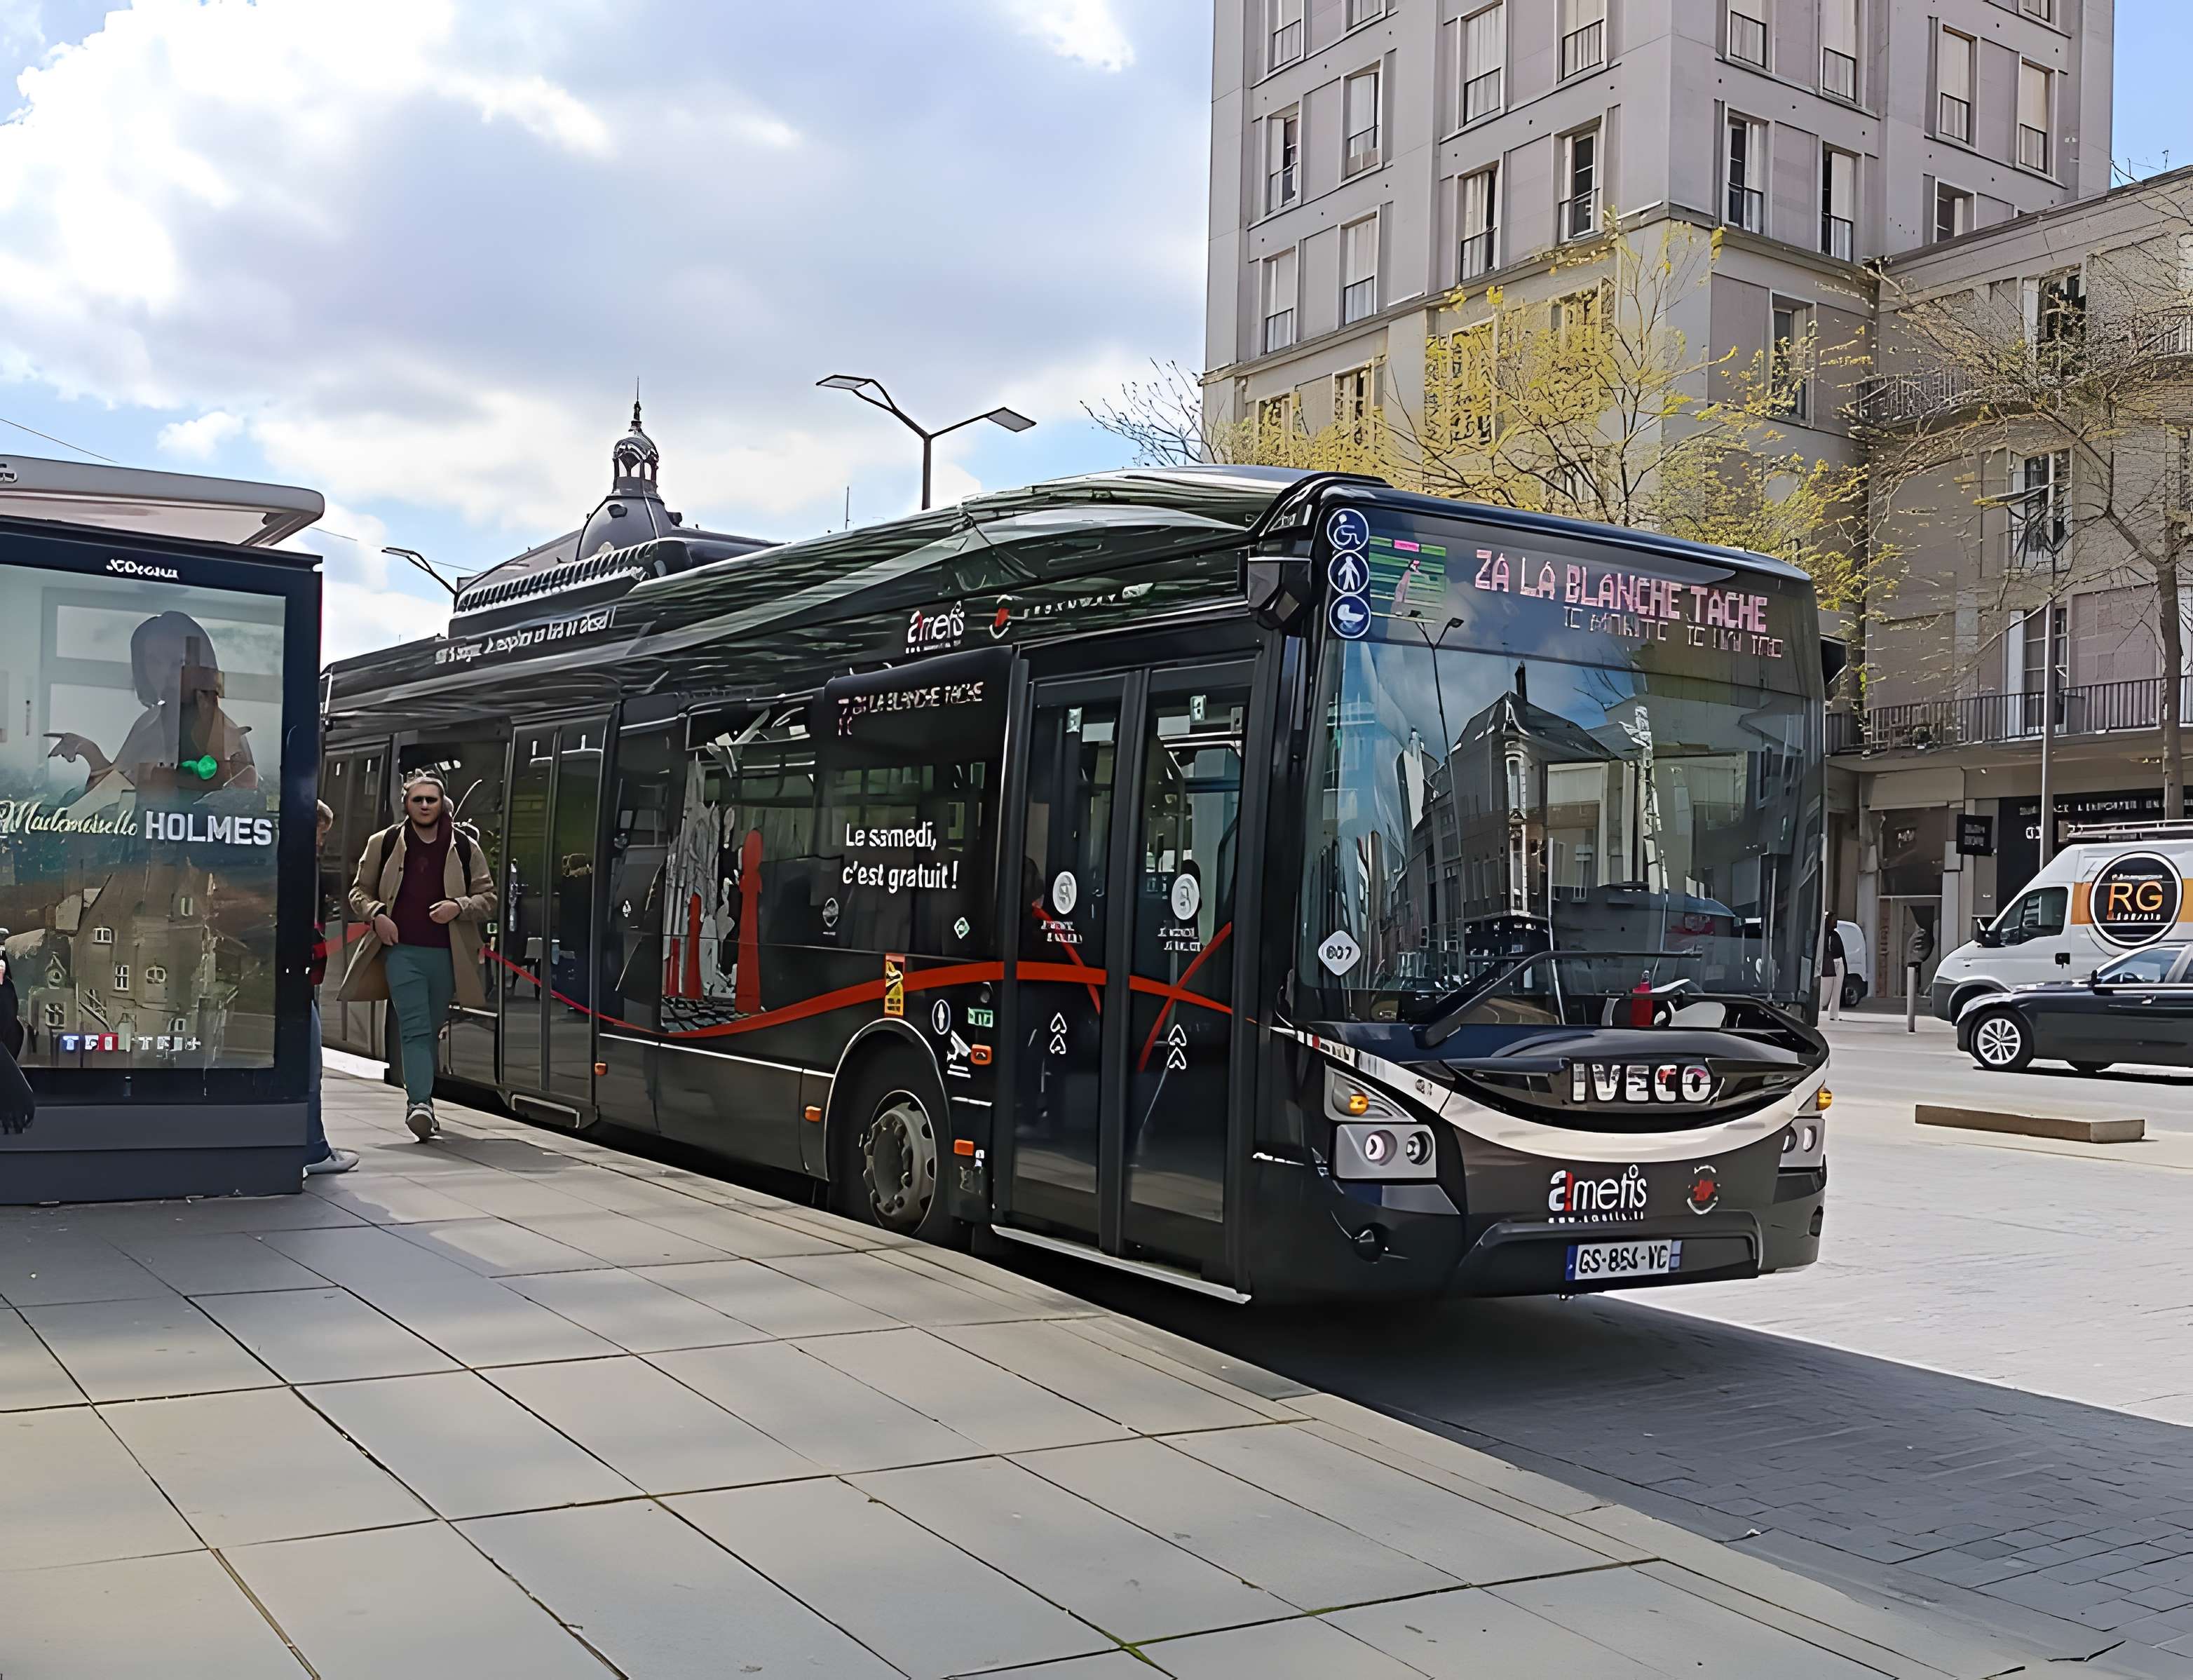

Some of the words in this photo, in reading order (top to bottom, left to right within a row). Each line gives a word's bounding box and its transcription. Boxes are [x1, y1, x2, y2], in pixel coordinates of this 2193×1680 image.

[1565, 564, 1683, 620] BLANCHE
[1690, 585, 1767, 632] TACHE
[145, 811, 273, 846] HOLMES
[846, 822, 865, 846] Le
[869, 821, 937, 851] samedi,
[842, 860, 884, 886] c'est
[2107, 881, 2164, 914] RG
[1573, 1063, 1711, 1102] IVECO
